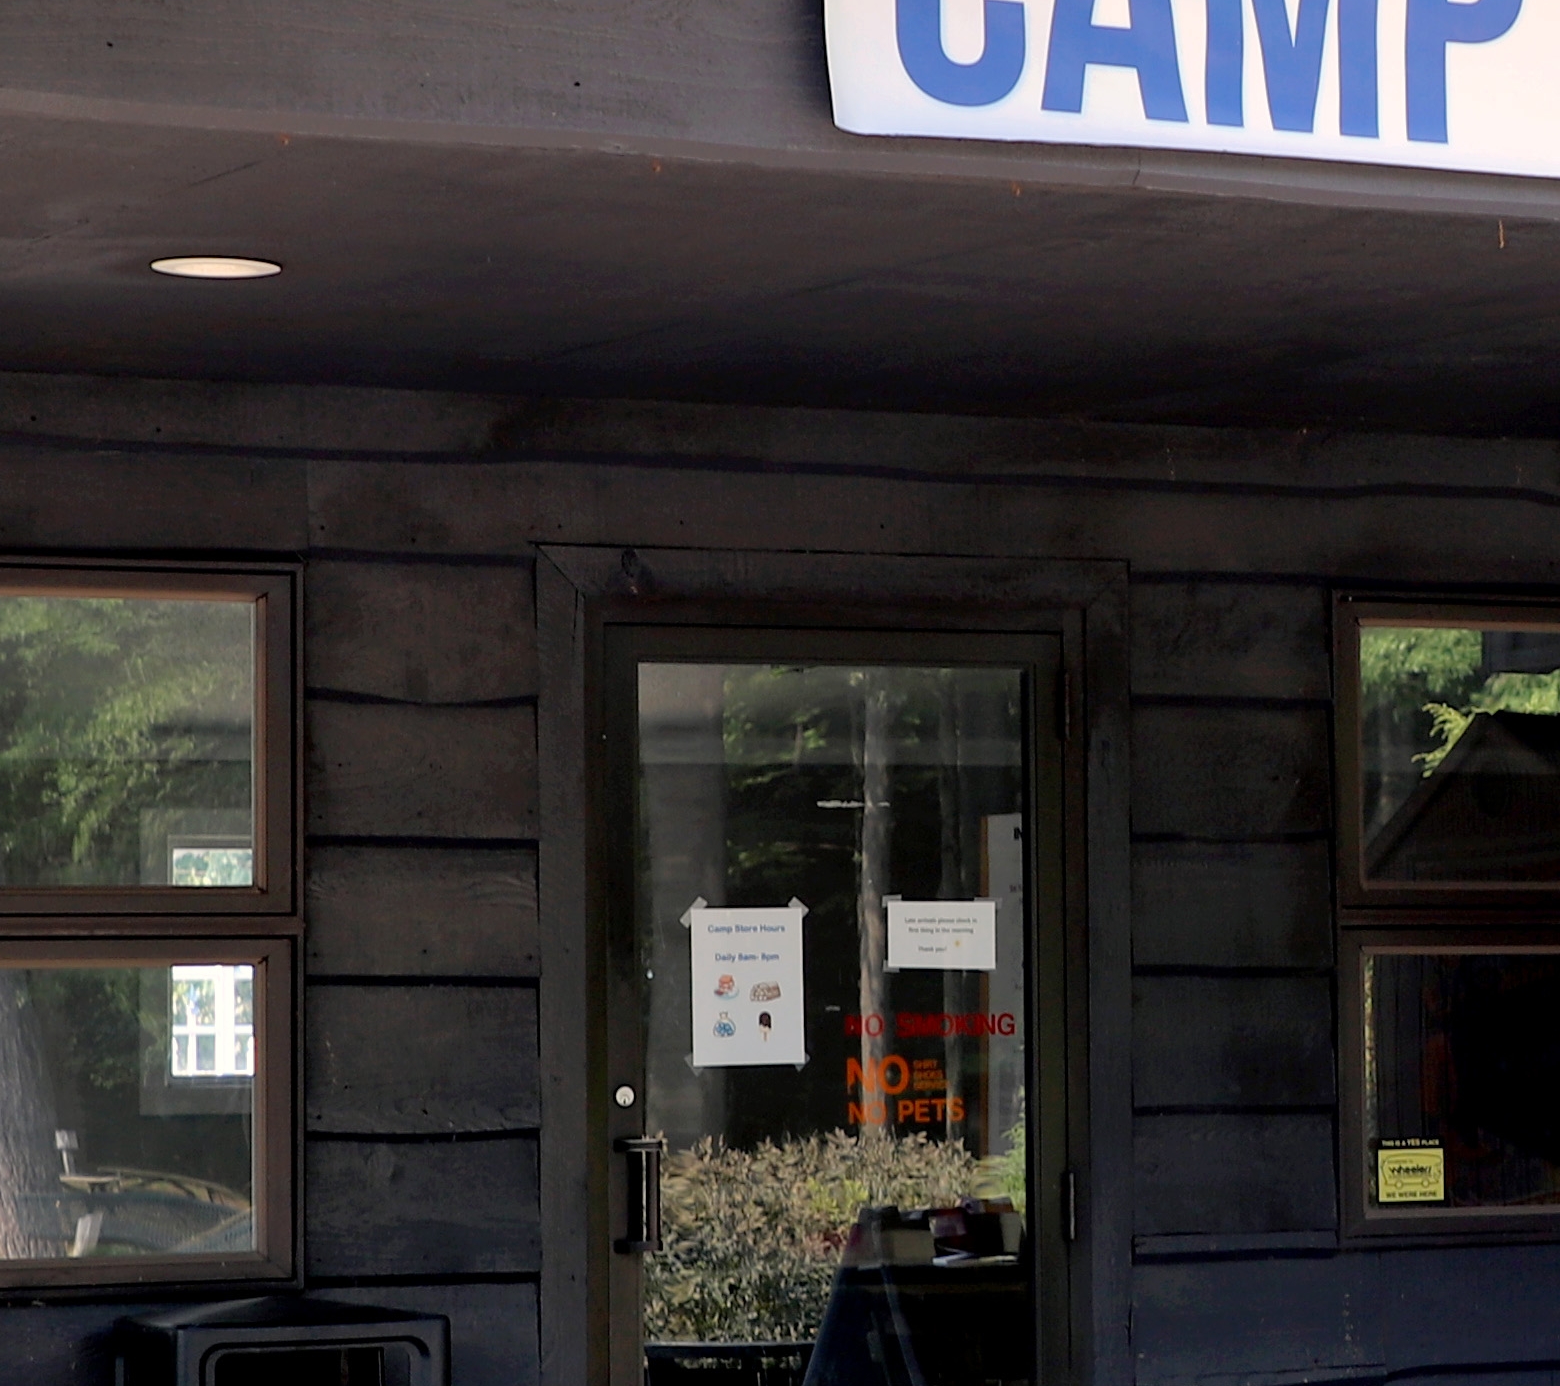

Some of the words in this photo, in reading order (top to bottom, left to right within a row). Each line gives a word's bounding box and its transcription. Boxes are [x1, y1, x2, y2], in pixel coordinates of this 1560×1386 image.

[707, 924, 733, 934] Camp
[735, 924, 758, 933] Store
[760, 924, 786, 933] Hours
[715, 953, 737, 963] Daily
[844, 1014, 886, 1038] NO
[895, 1012, 1016, 1038] SMOKING
[846, 1054, 910, 1095] NO
[848, 1101, 887, 1125] NO
[897, 1097, 966, 1124] PETS
